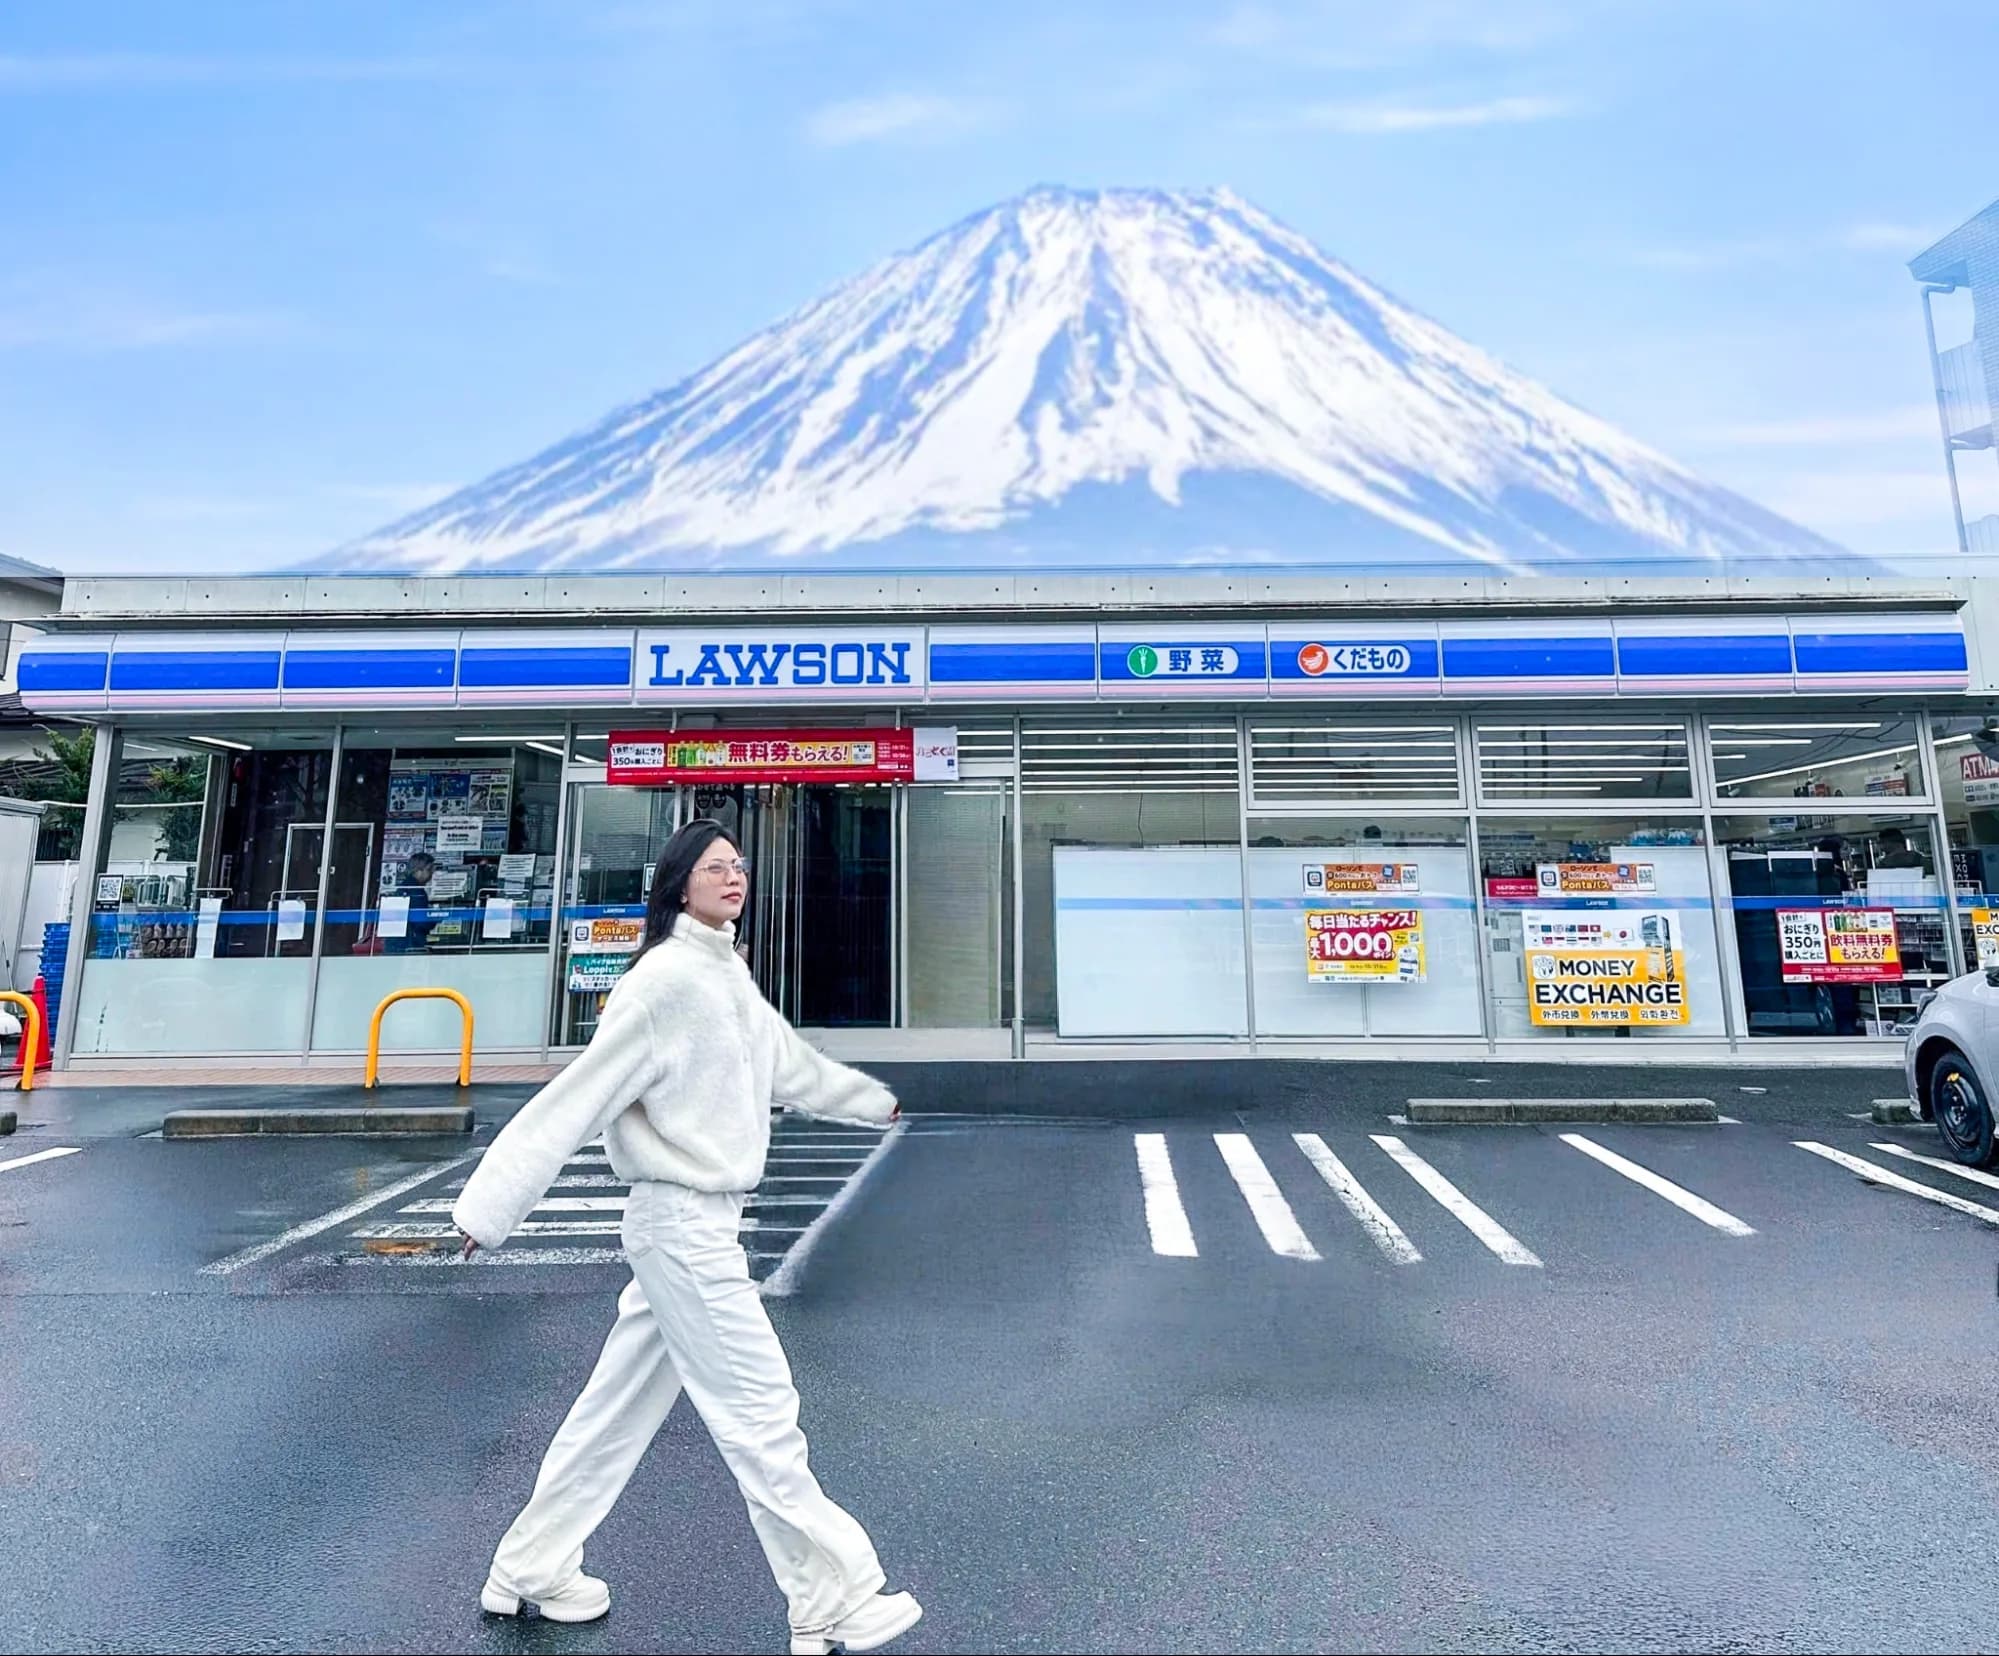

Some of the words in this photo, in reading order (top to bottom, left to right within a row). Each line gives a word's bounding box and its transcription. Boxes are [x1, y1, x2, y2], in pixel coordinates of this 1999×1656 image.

[649, 643, 911, 686] LAWSON
[1168, 649, 1225, 672] 野菜
[1333, 647, 1404, 671] くだもの
[1327, 880, 1374, 889] Pontaパス
[1561, 880, 1609, 889] Pontaパス
[1309, 911, 1417, 929] 毎日当たるチャンス!
[1783, 924, 1820, 935] おにぎり
[1784, 936, 1822, 949] 350円
[1830, 934, 1893, 947] 飲料無料券
[1784, 950, 1825, 960] 購入ごとに
[1841, 947, 1886, 960] もらえる!
[1559, 959, 1635, 976] MONEY
[1534, 983, 1682, 1005] EXCHANGE
